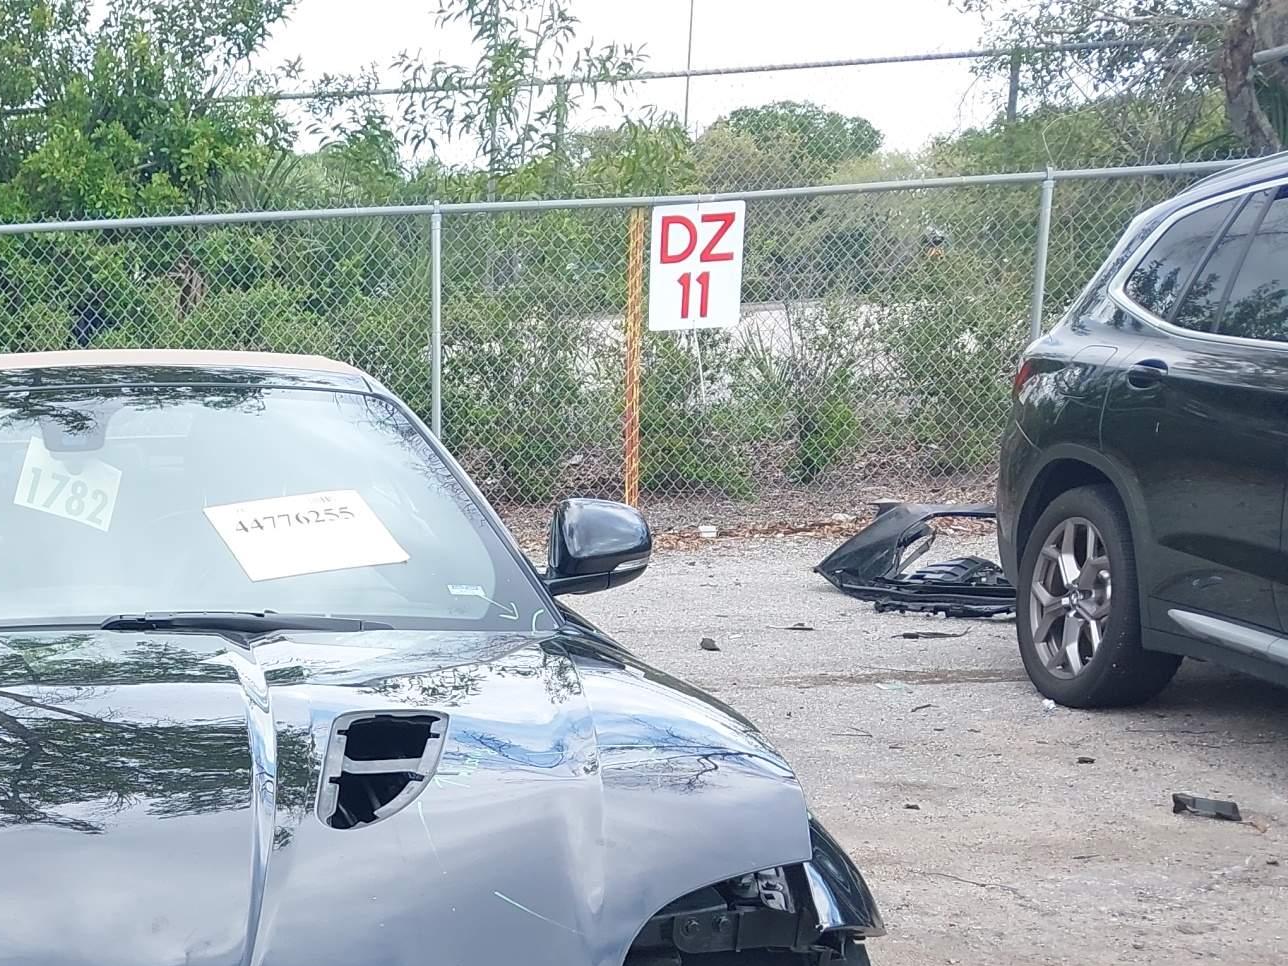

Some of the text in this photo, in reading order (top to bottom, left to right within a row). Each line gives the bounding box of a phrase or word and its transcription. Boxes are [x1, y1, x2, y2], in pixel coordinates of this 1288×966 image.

[660, 212, 736, 264] DZ
[677, 271, 710, 319] 11
[27, 466, 108, 526] 1782
[235, 506, 355, 533] 44776255
